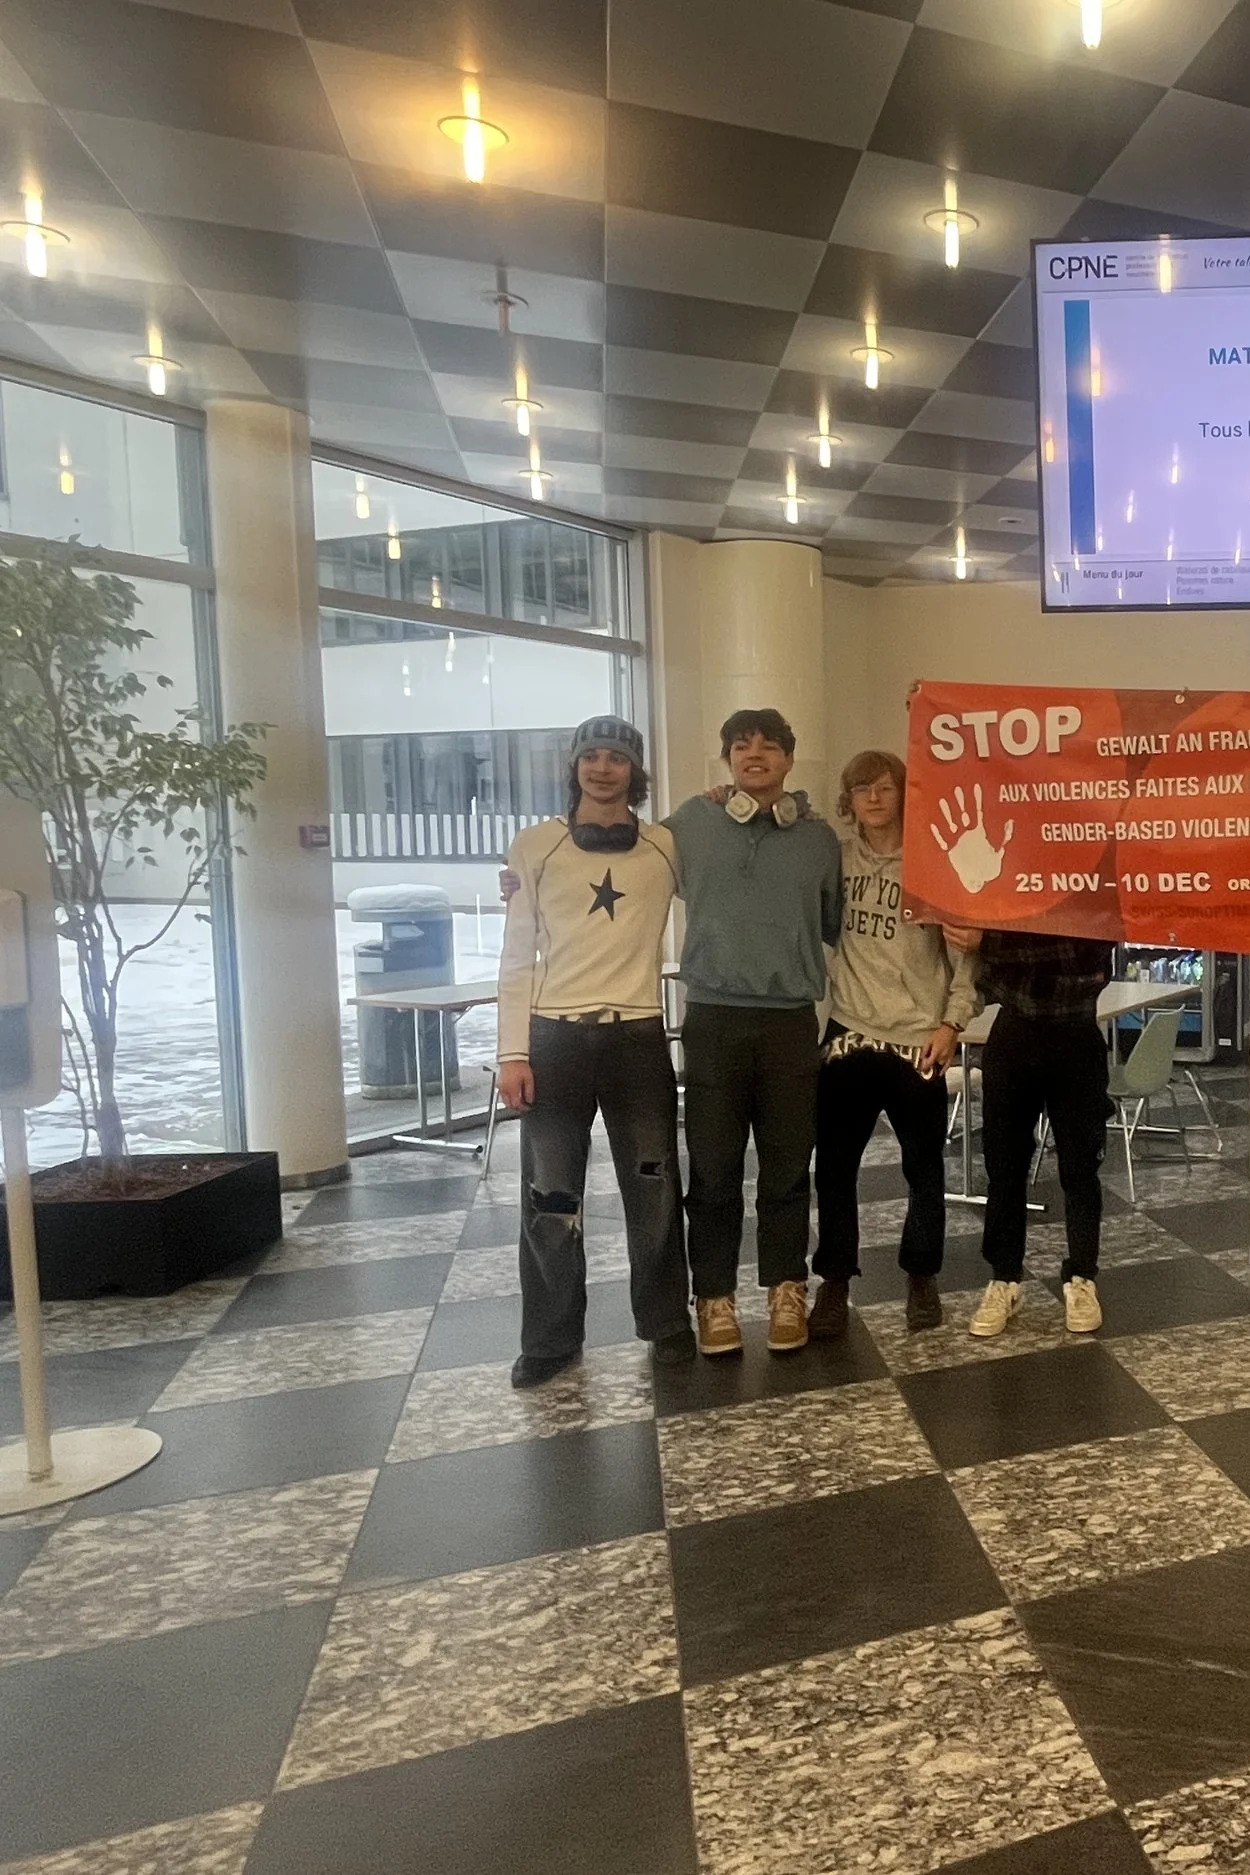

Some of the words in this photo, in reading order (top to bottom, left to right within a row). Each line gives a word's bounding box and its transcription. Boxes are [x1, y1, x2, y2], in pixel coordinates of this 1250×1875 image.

[1050, 255, 1119, 279] CPNE
[1203, 257, 1231, 270] Votre
[1199, 422, 1243, 437] Tous
[1083, 569, 1109, 579] Menu
[1112, 569, 1122, 579] du
[1125, 570, 1143, 580] jour
[930, 706, 1082, 761] STOP
[1097, 735, 1170, 757] GEWALT
[1176, 732, 1203, 752] AN
[999, 785, 1030, 802] AUX
[1033, 781, 1130, 801] VIOLENCES
[1136, 777, 1199, 798] FAITES
[1205, 775, 1243, 795] AUX
[1041, 820, 1177, 842] GENDER-BASED
[1015, 873, 1043, 892] 25
[1052, 874, 1099, 892] NOV
[1121, 874, 1149, 892] 10
[1158, 873, 1211, 892] DEC
[846, 909, 897, 940] JETS
